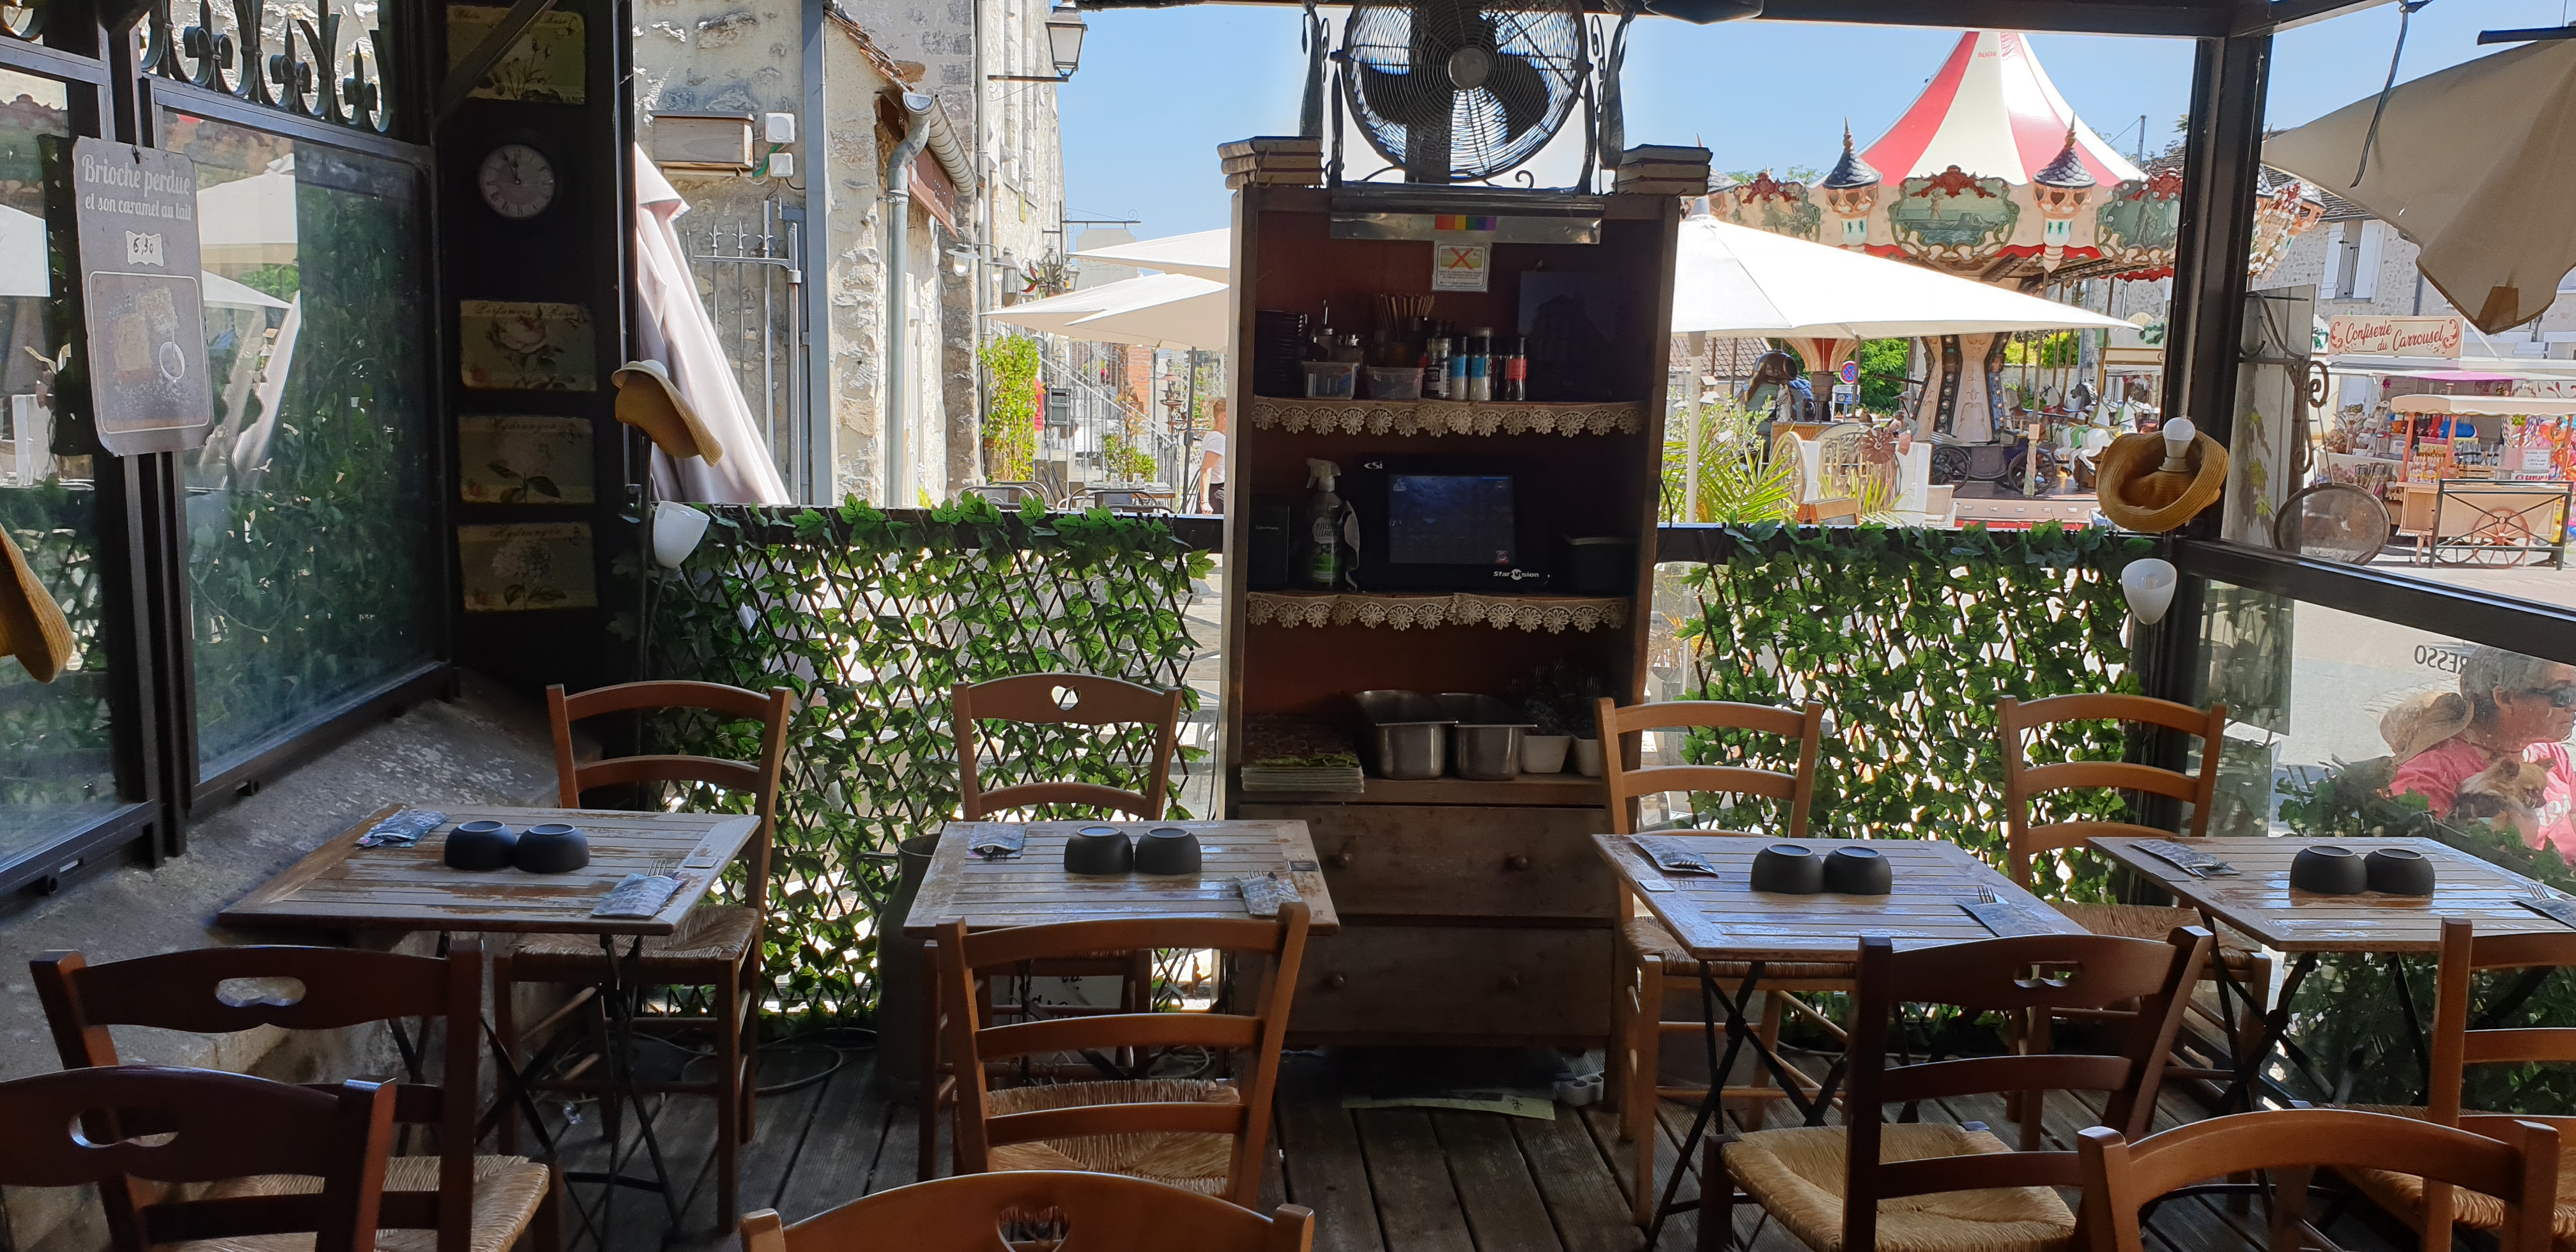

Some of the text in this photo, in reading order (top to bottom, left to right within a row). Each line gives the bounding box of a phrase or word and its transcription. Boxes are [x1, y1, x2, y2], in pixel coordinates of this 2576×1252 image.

[81, 154, 191, 197] Brioche perdue
[98, 197, 117, 213] son
[118, 200, 160, 217] caramel
[161, 206, 174, 218] au
[176, 203, 192, 221] lait
[2345, 320, 2393, 346] Confiserie
[2377, 324, 2444, 352] du Carrousel
